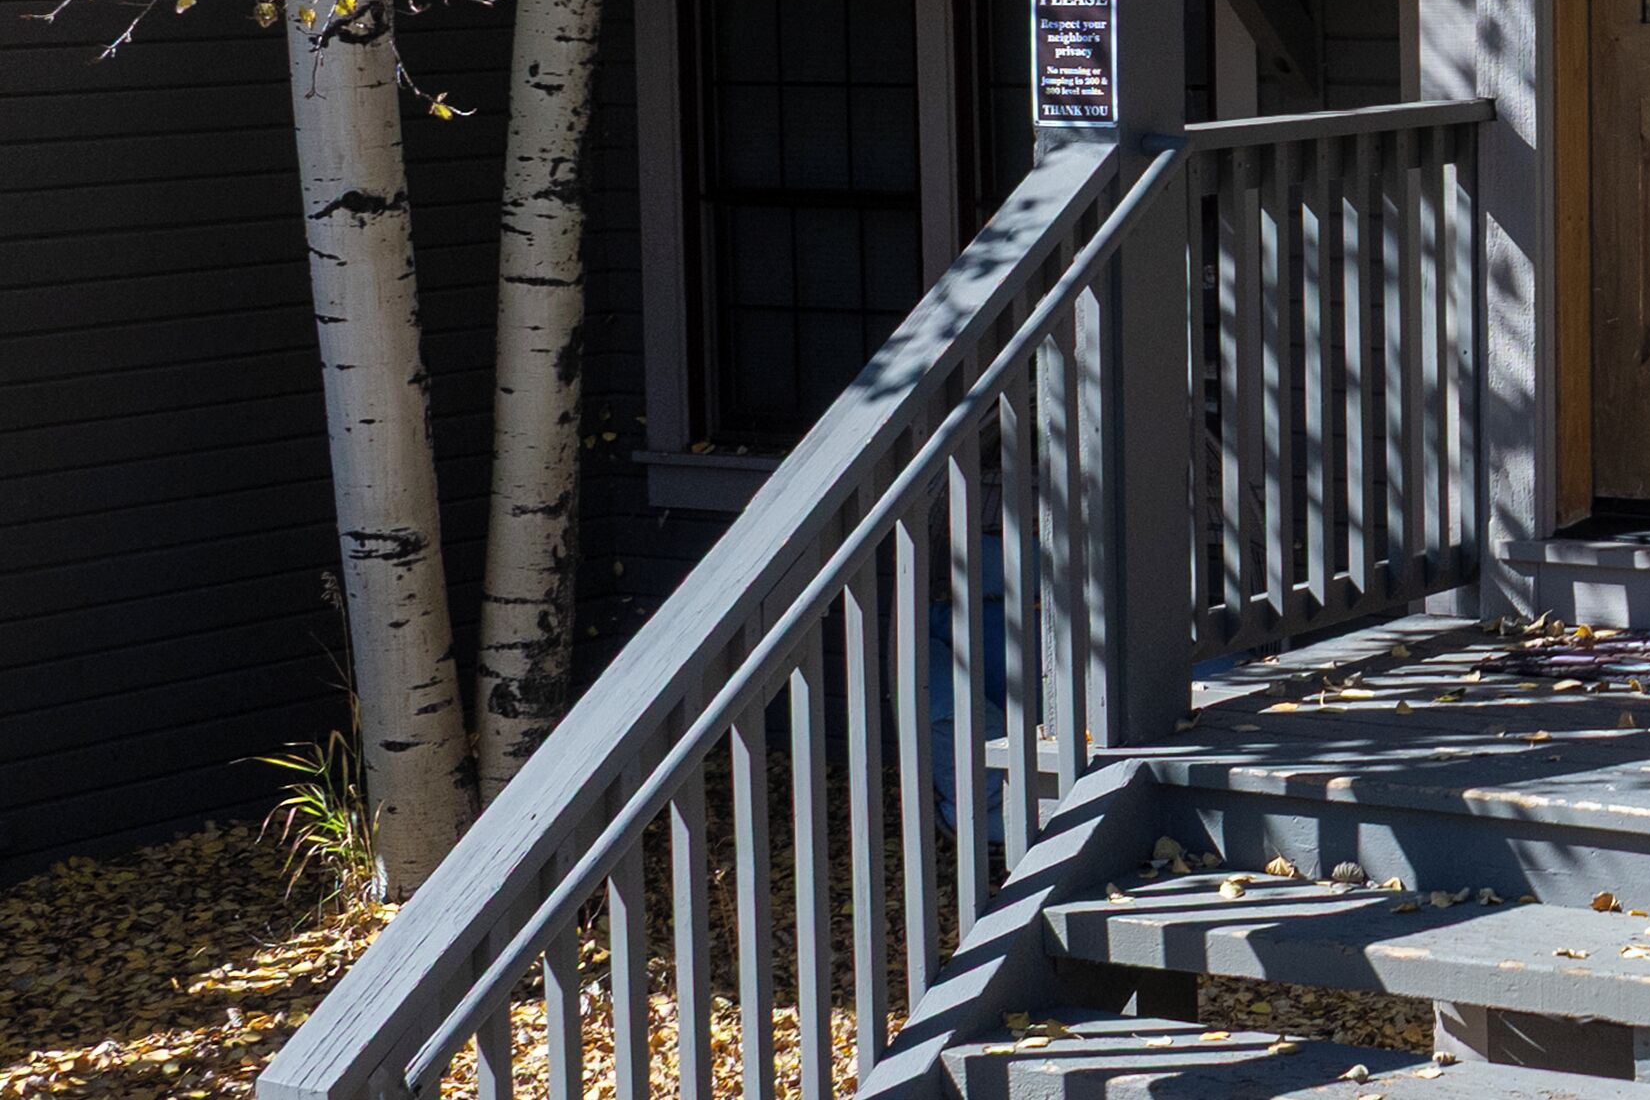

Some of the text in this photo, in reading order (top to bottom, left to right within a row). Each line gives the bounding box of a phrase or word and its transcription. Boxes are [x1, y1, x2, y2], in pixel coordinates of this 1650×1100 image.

[1041, 19, 1107, 31] Respect your
[1047, 31, 1101, 45] neighbor's
[1055, 45, 1093, 58] privacy
[1046, 66, 1059, 75] No
[1060, 66, 1091, 76] running
[1061, 87, 1080, 95] level
[1042, 105, 1109, 116] THANK YOU
